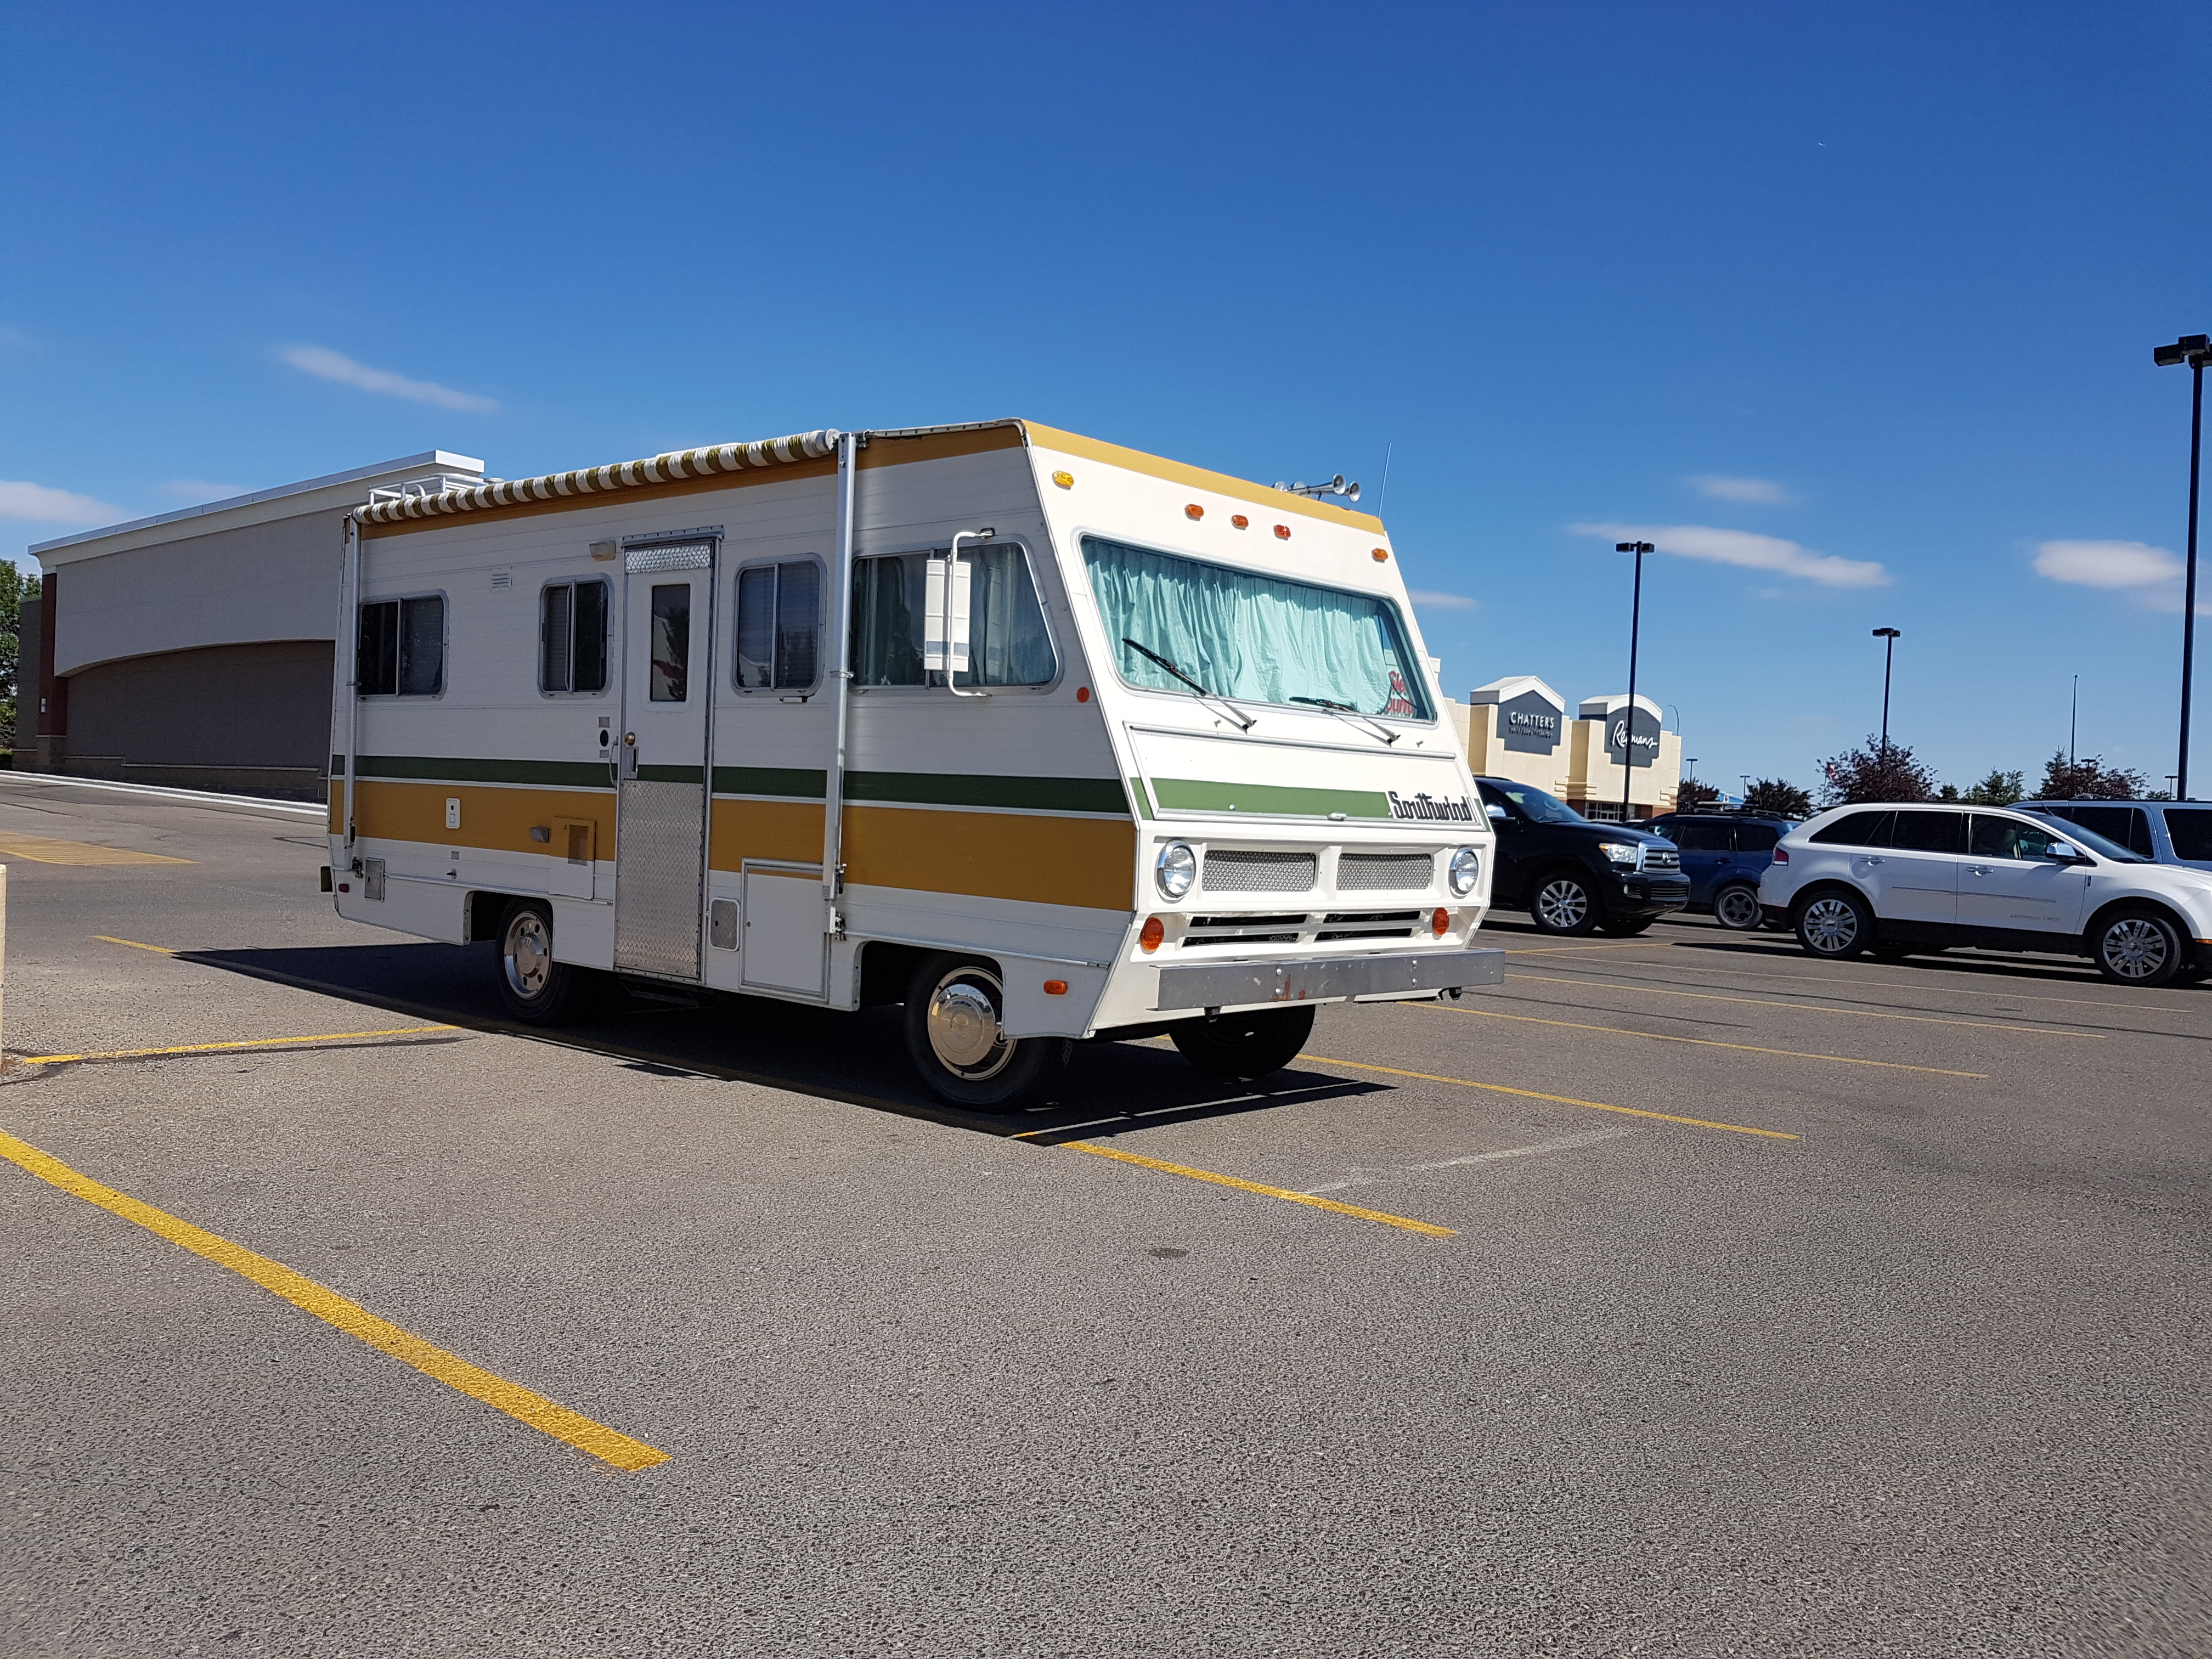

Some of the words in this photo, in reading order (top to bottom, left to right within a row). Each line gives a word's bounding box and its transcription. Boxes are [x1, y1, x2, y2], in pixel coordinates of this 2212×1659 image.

[1510, 711, 1555, 729] CHATTERS
[1612, 720, 1658, 749] Reimans
[1387, 791, 1473, 821] Southwind
